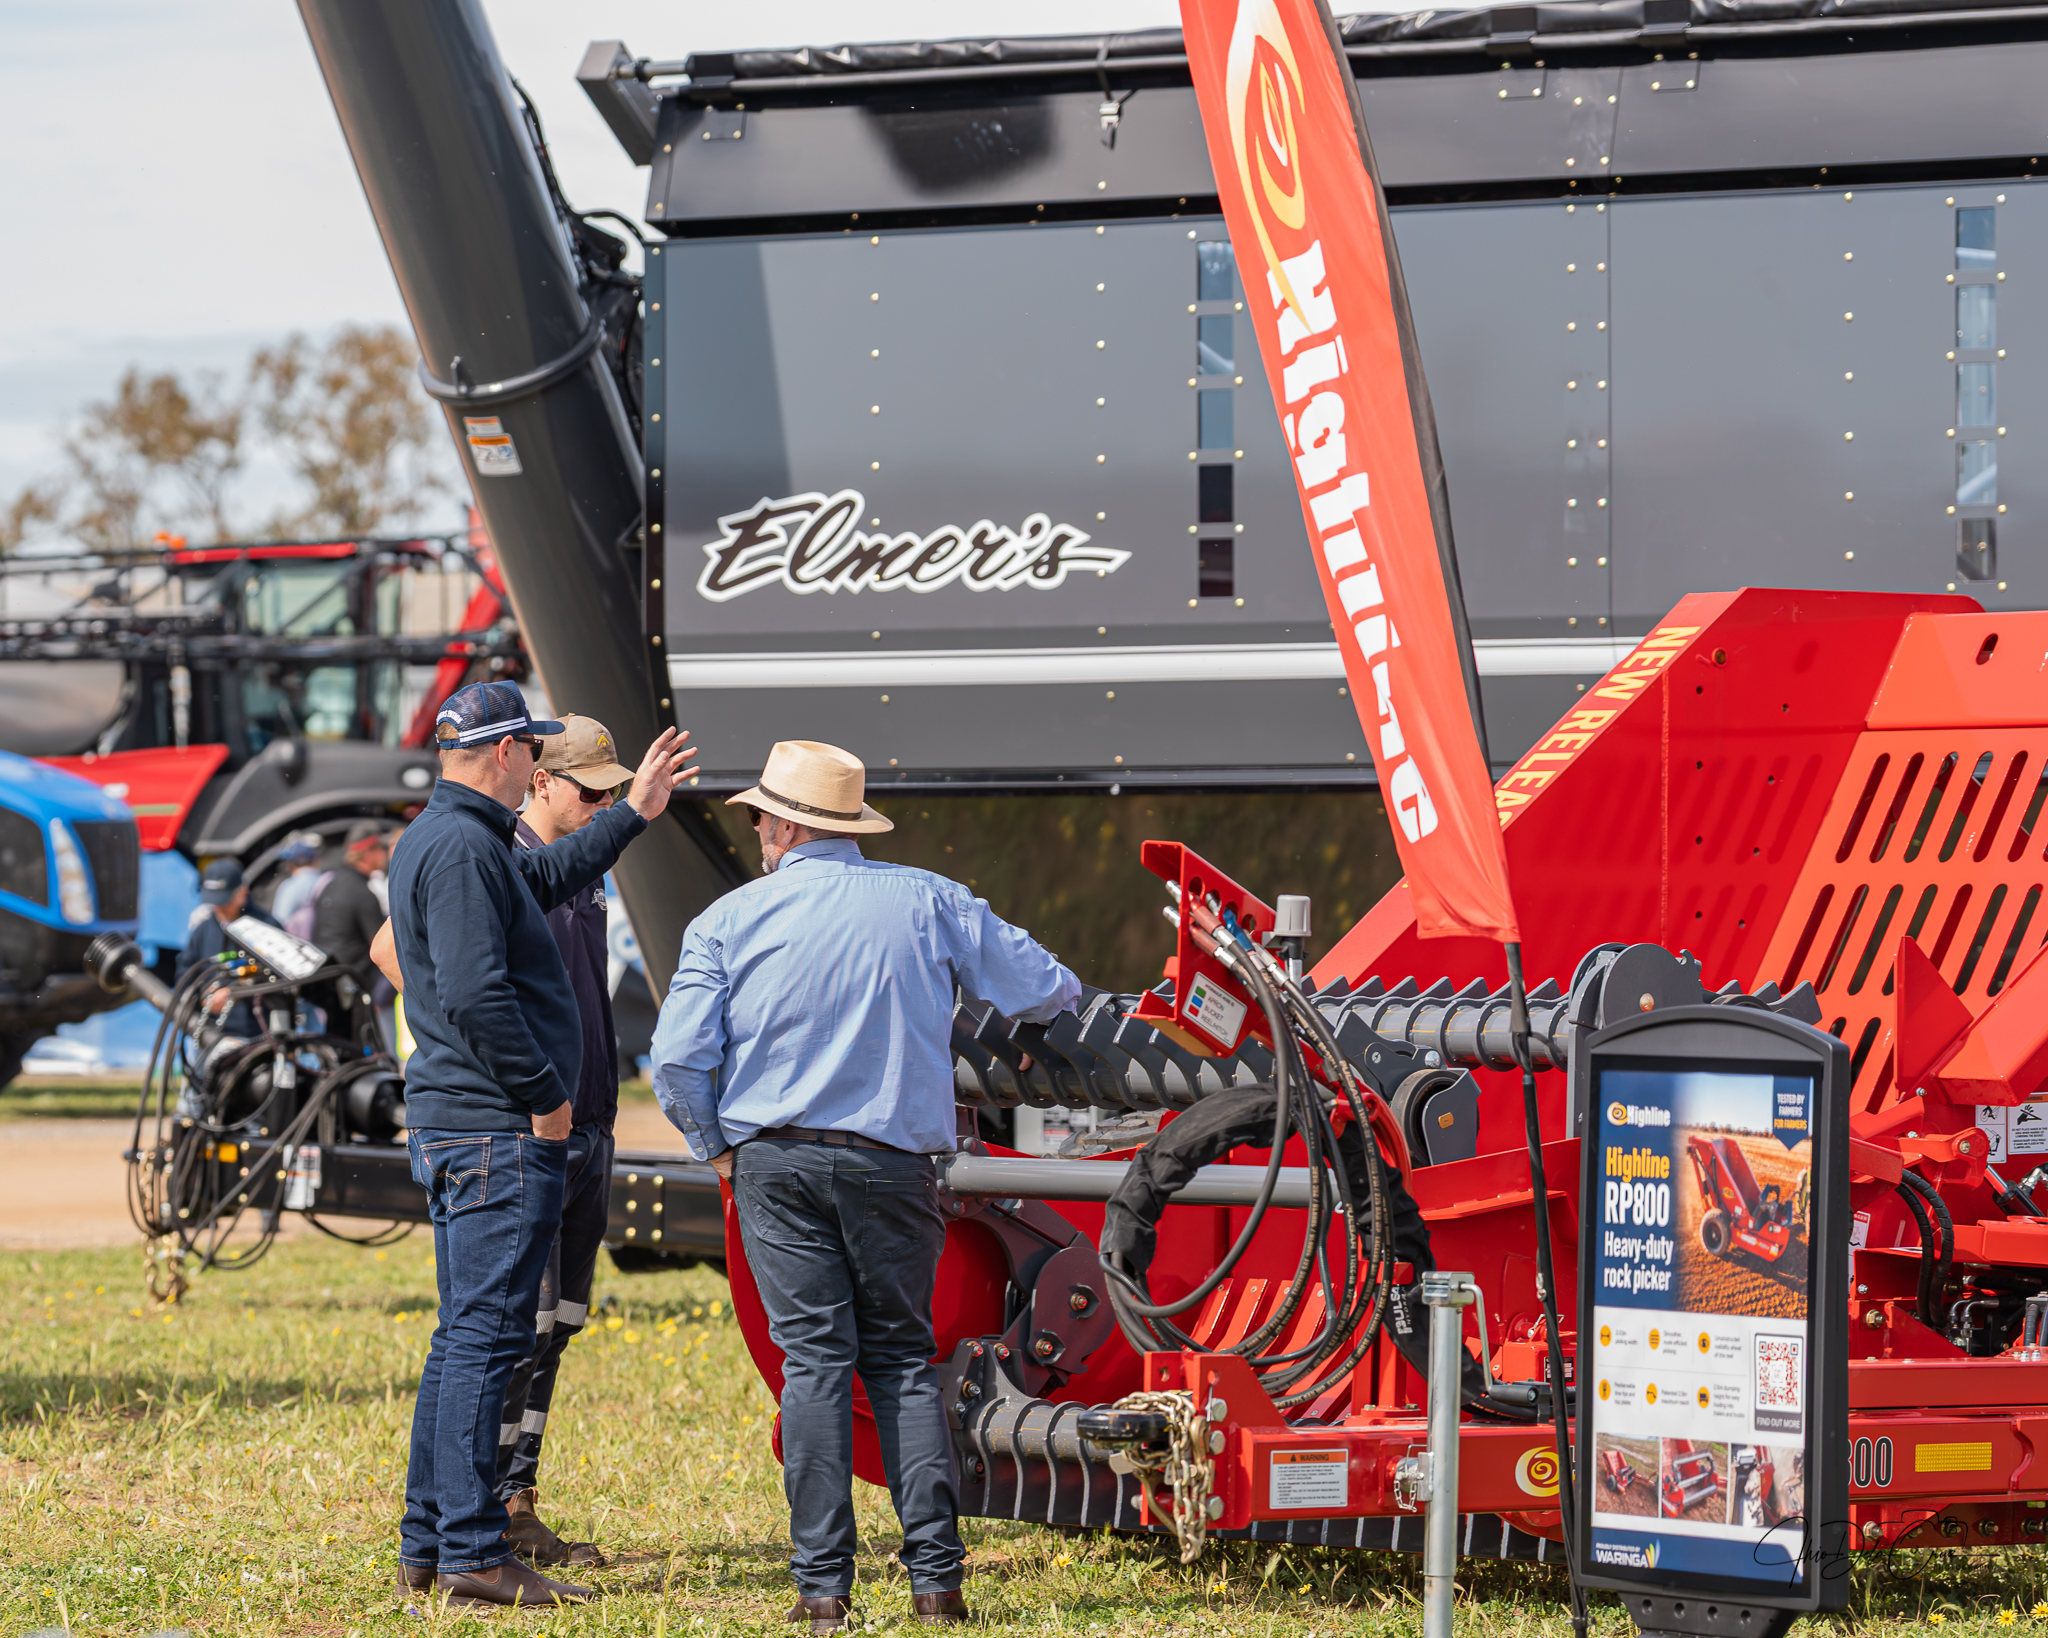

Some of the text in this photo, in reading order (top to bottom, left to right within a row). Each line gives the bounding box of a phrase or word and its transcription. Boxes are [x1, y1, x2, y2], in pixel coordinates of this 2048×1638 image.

[697, 489, 1132, 601] Elmer's
[1594, 626, 1701, 700] NEW
[1204, 1005, 1224, 1021] BUCKET
[1208, 996, 1225, 1011] APRON
[1339, 1060, 1361, 1104] PULSAR
[1627, 1105, 1671, 1128] Highline
[1605, 1147, 1670, 1182] Highline
[1604, 1181, 1670, 1227] RP800
[1346, 1203, 1357, 1249] PULSAR
[1604, 1231, 1674, 1266] Heavy-duty
[1603, 1263, 1671, 1294] rock picker
[1390, 1286, 1413, 1334] PULSA
[1757, 1417, 1801, 1429] FIND OUT MORE
[1848, 1436, 1893, 1488] 00
[1595, 1549, 1649, 1568] WARINGA
